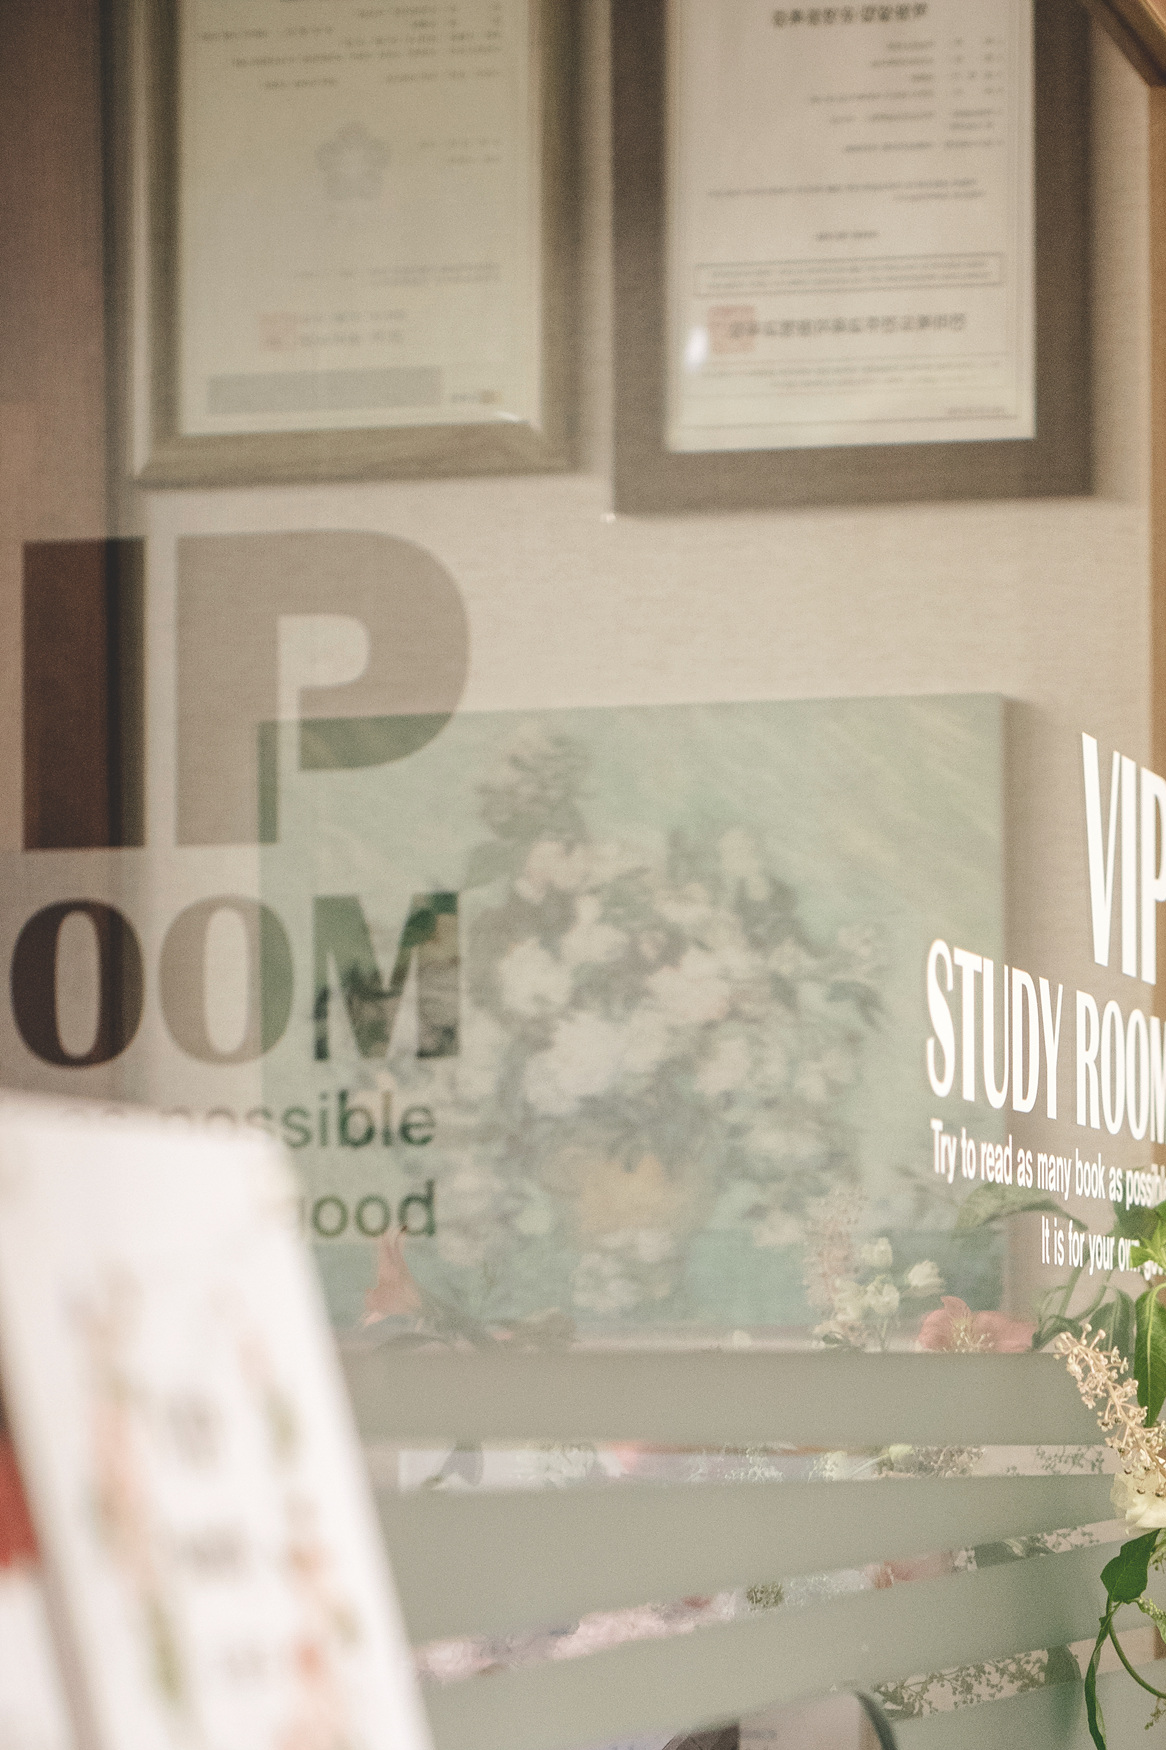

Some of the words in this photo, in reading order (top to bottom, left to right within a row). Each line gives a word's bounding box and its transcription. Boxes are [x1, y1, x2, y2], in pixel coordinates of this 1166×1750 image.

[22, 529, 470, 853] IP
[10, 892, 460, 1070] OOM
[926, 938, 1064, 1120] STUDY
[300, 1178, 436, 1238] ood
[930, 1118, 958, 1184] Try
[961, 1127, 977, 1179] to
[981, 1134, 1013, 1185] read
[1017, 1148, 1034, 1189] as
[1037, 1152, 1072, 1201] many
[1075, 1148, 1106, 1199] book
[1109, 1166, 1123, 1202] as
[1042, 1215, 1050, 1264] It
[1054, 1217, 1065, 1266] is
[1068, 1220, 1085, 1268] for
[1089, 1234, 1115, 1276] your
